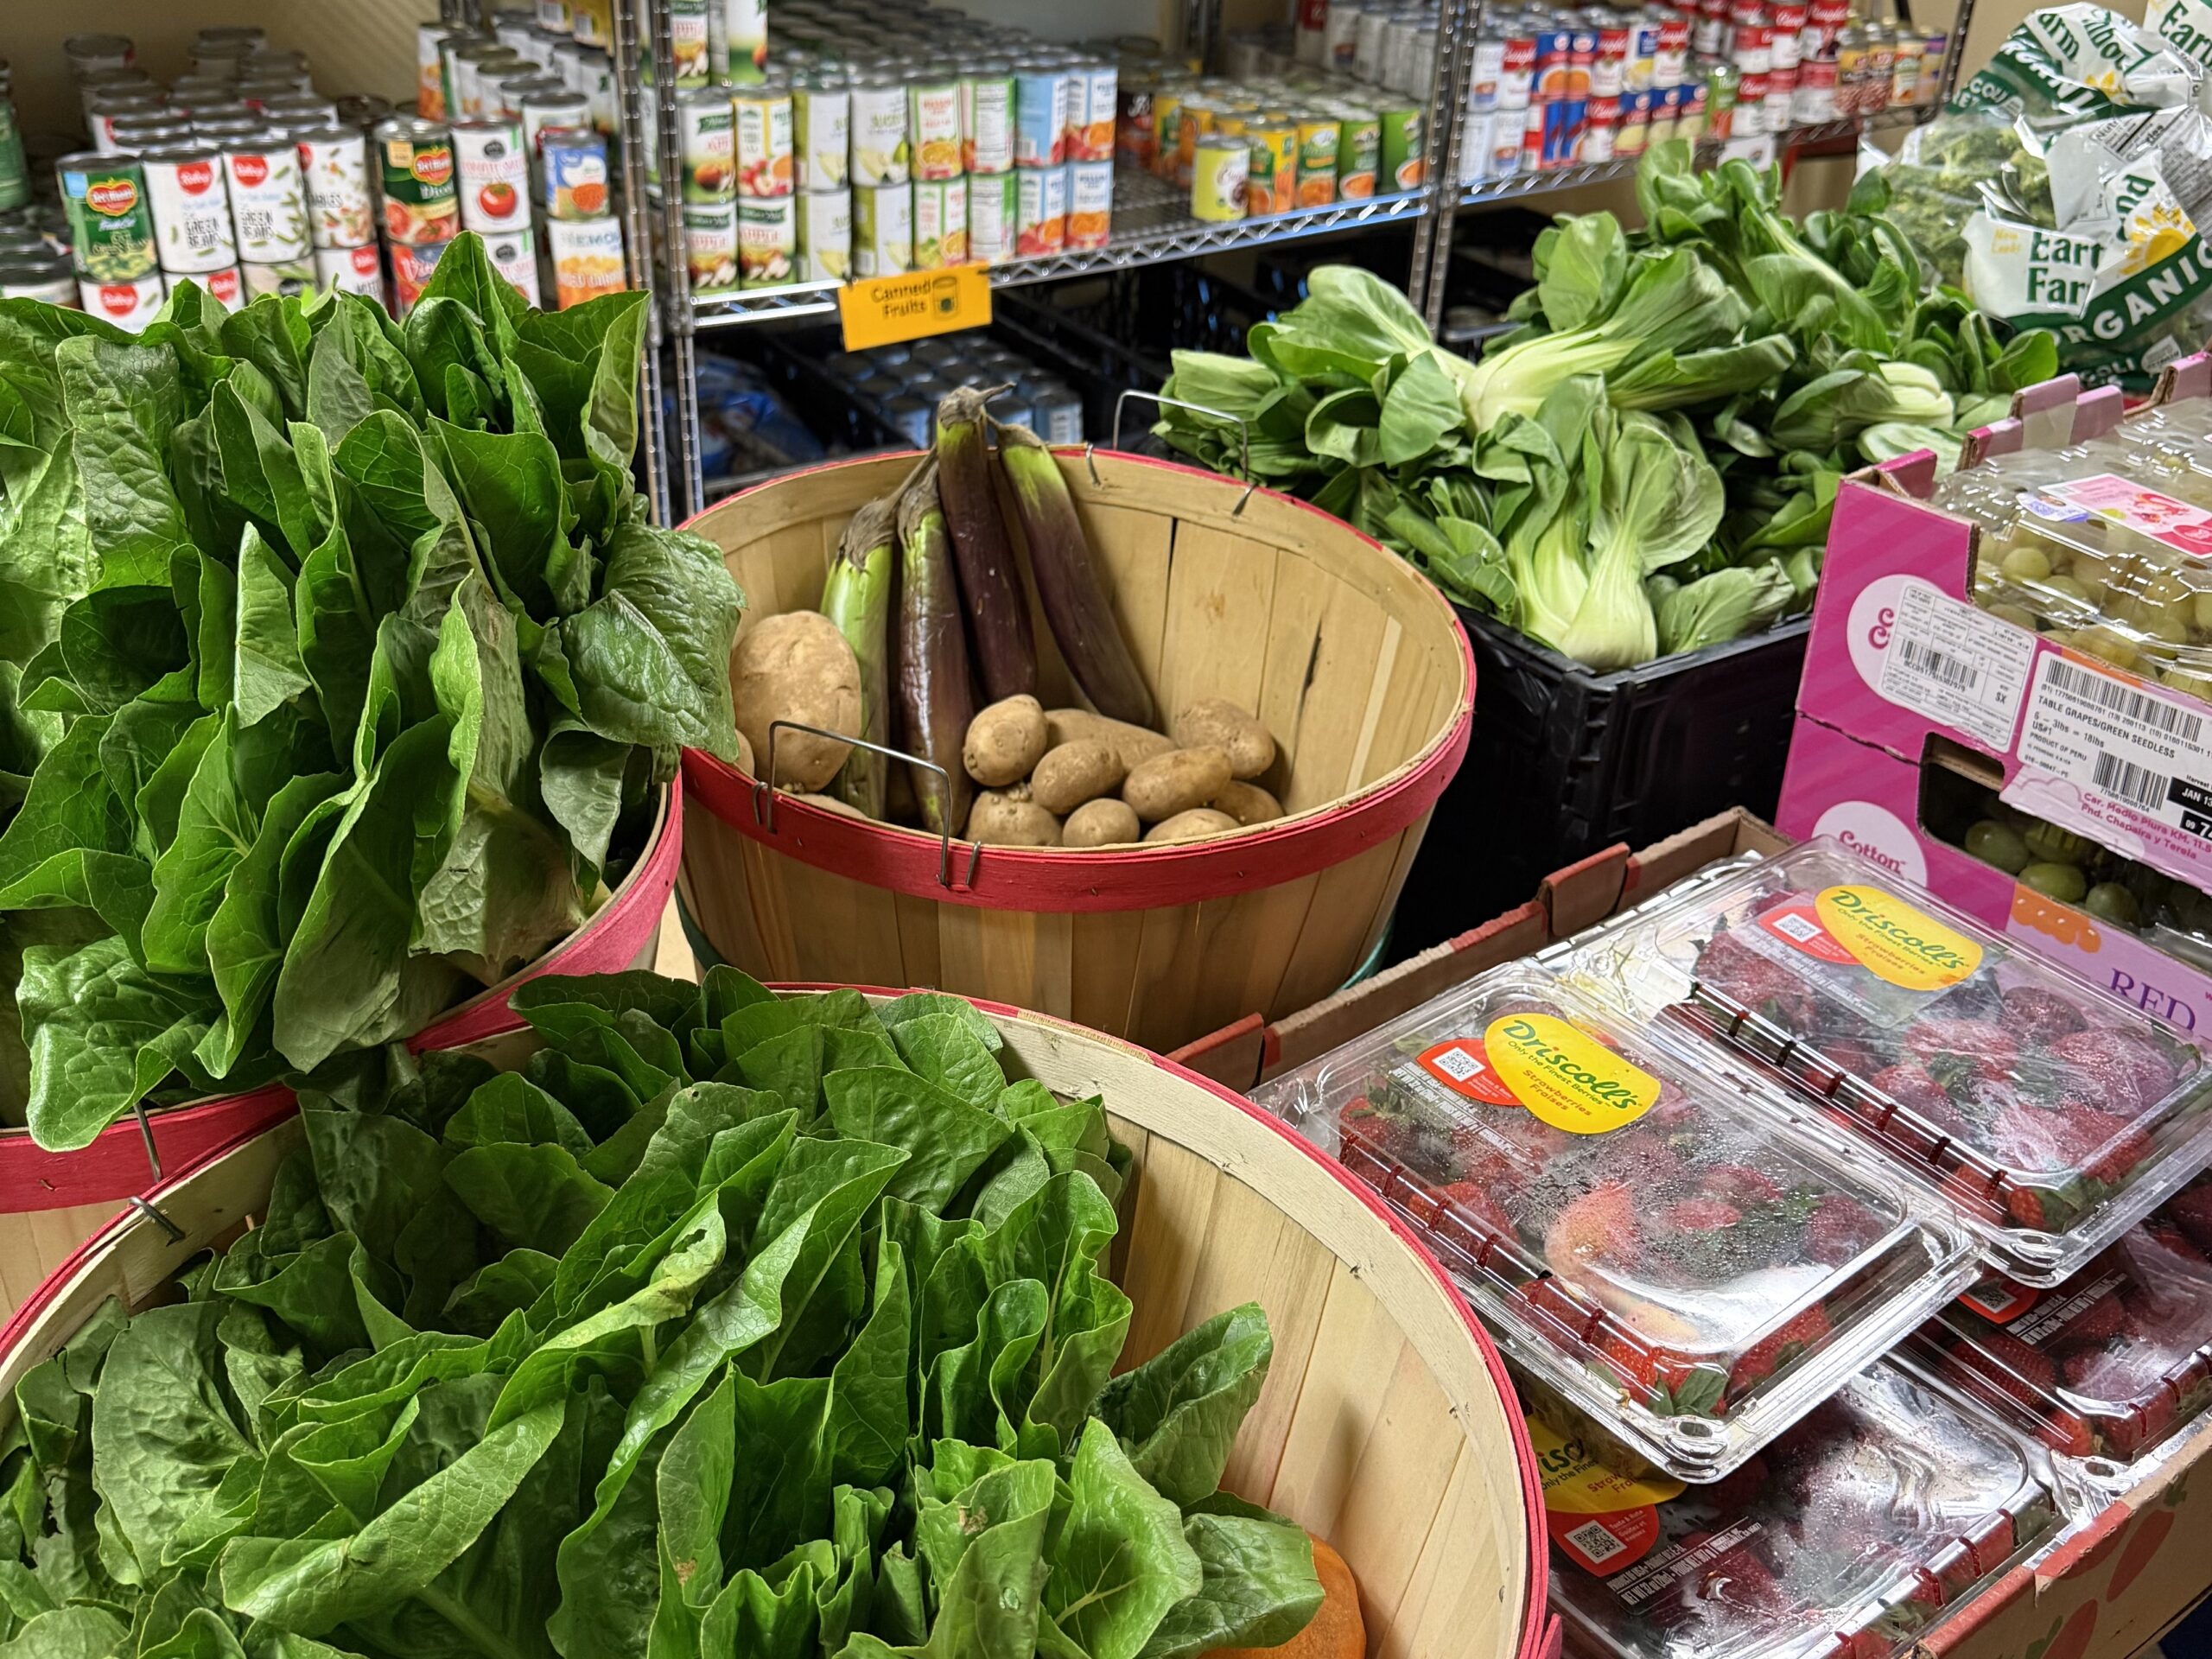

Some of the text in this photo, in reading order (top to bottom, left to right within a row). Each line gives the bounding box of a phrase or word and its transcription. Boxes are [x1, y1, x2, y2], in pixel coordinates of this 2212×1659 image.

[2037, 13, 2080, 61] arm
[872, 279, 931, 303] Canned
[2027, 267, 2091, 305] Far
[2053, 238, 2212, 347] RGANIC
[883, 300, 927, 318] Fruits
[2030, 732, 2088, 761] PRODUCT OF PERU
[2038, 696, 2176, 759] TABLE GRAPES/GREEN SEEDLESS
[2182, 787, 2201, 803] JAN
[2186, 774, 2209, 789] Harvest
[2083, 792, 2105, 808] Car.
[2107, 802, 2139, 822] Medio
[2140, 817, 2169, 835] Piura
[2170, 827, 2190, 845] KM.
[2106, 813, 2152, 842] Chapaira
[2154, 834, 2162, 844] y
[2164, 838, 2197, 861] Terela
[1839, 830, 1902, 875] Cotton
[1831, 890, 1966, 969] Driscoll's
[1874, 928, 1902, 949] Finest
[1855, 932, 1926, 976] Strawberries
[1865, 945, 1904, 970] Fraises
[2110, 968, 2196, 1031] RED
[1503, 1020, 1637, 1109] Driscoll's
[1508, 1040, 1605, 1107] Only the Finest Berries
[1522, 1069, 1592, 1116] Strawberries
[1529, 1084, 1568, 1111] Fraises
[1560, 1470, 1576, 1481] the
